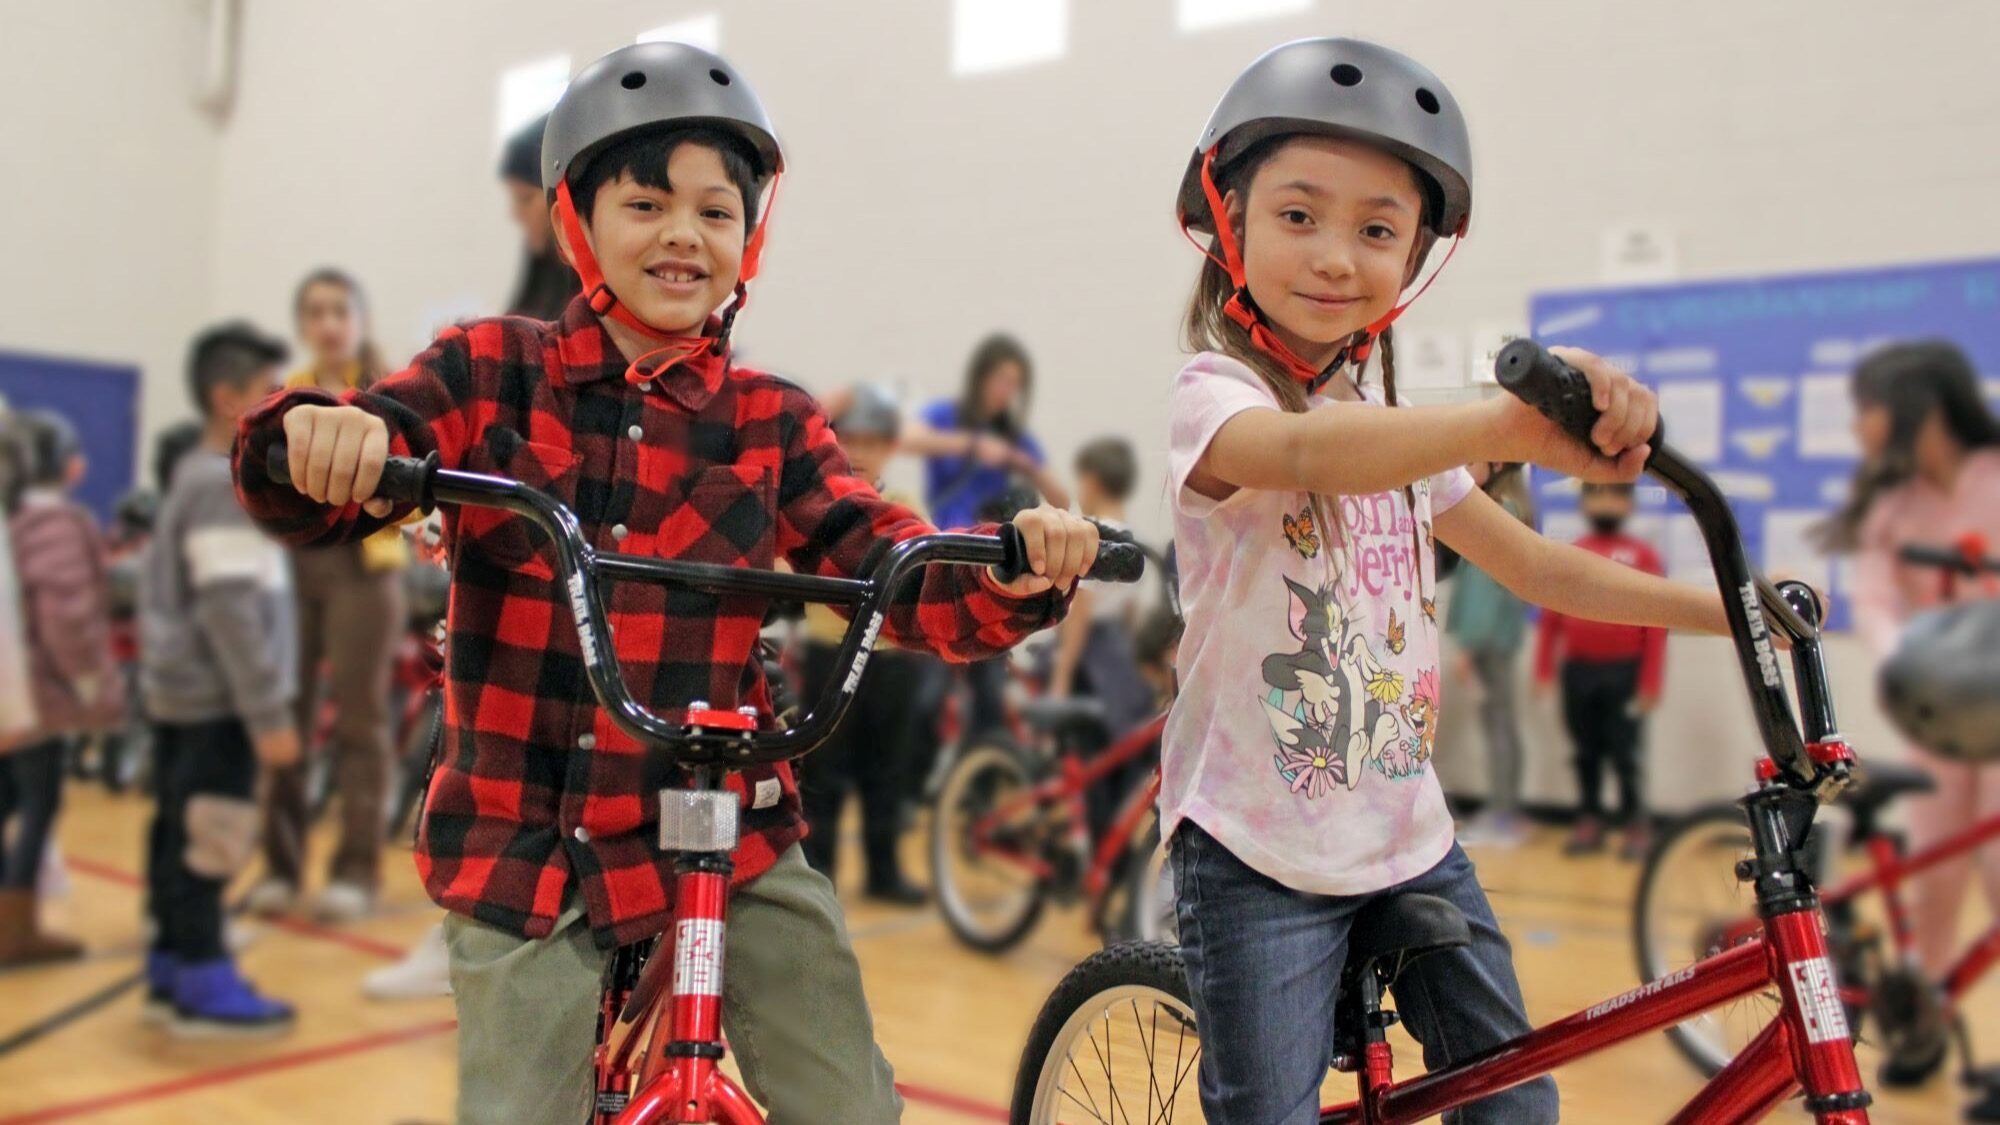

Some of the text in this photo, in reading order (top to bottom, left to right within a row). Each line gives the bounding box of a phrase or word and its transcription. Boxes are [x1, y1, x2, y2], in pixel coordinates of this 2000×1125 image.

[567, 571, 591, 627] TRAIL
[1350, 535, 1416, 602] Jerry
[842, 610, 884, 695] TRAIL BOSS
[1739, 581, 1780, 687] TRAIL BOSS
